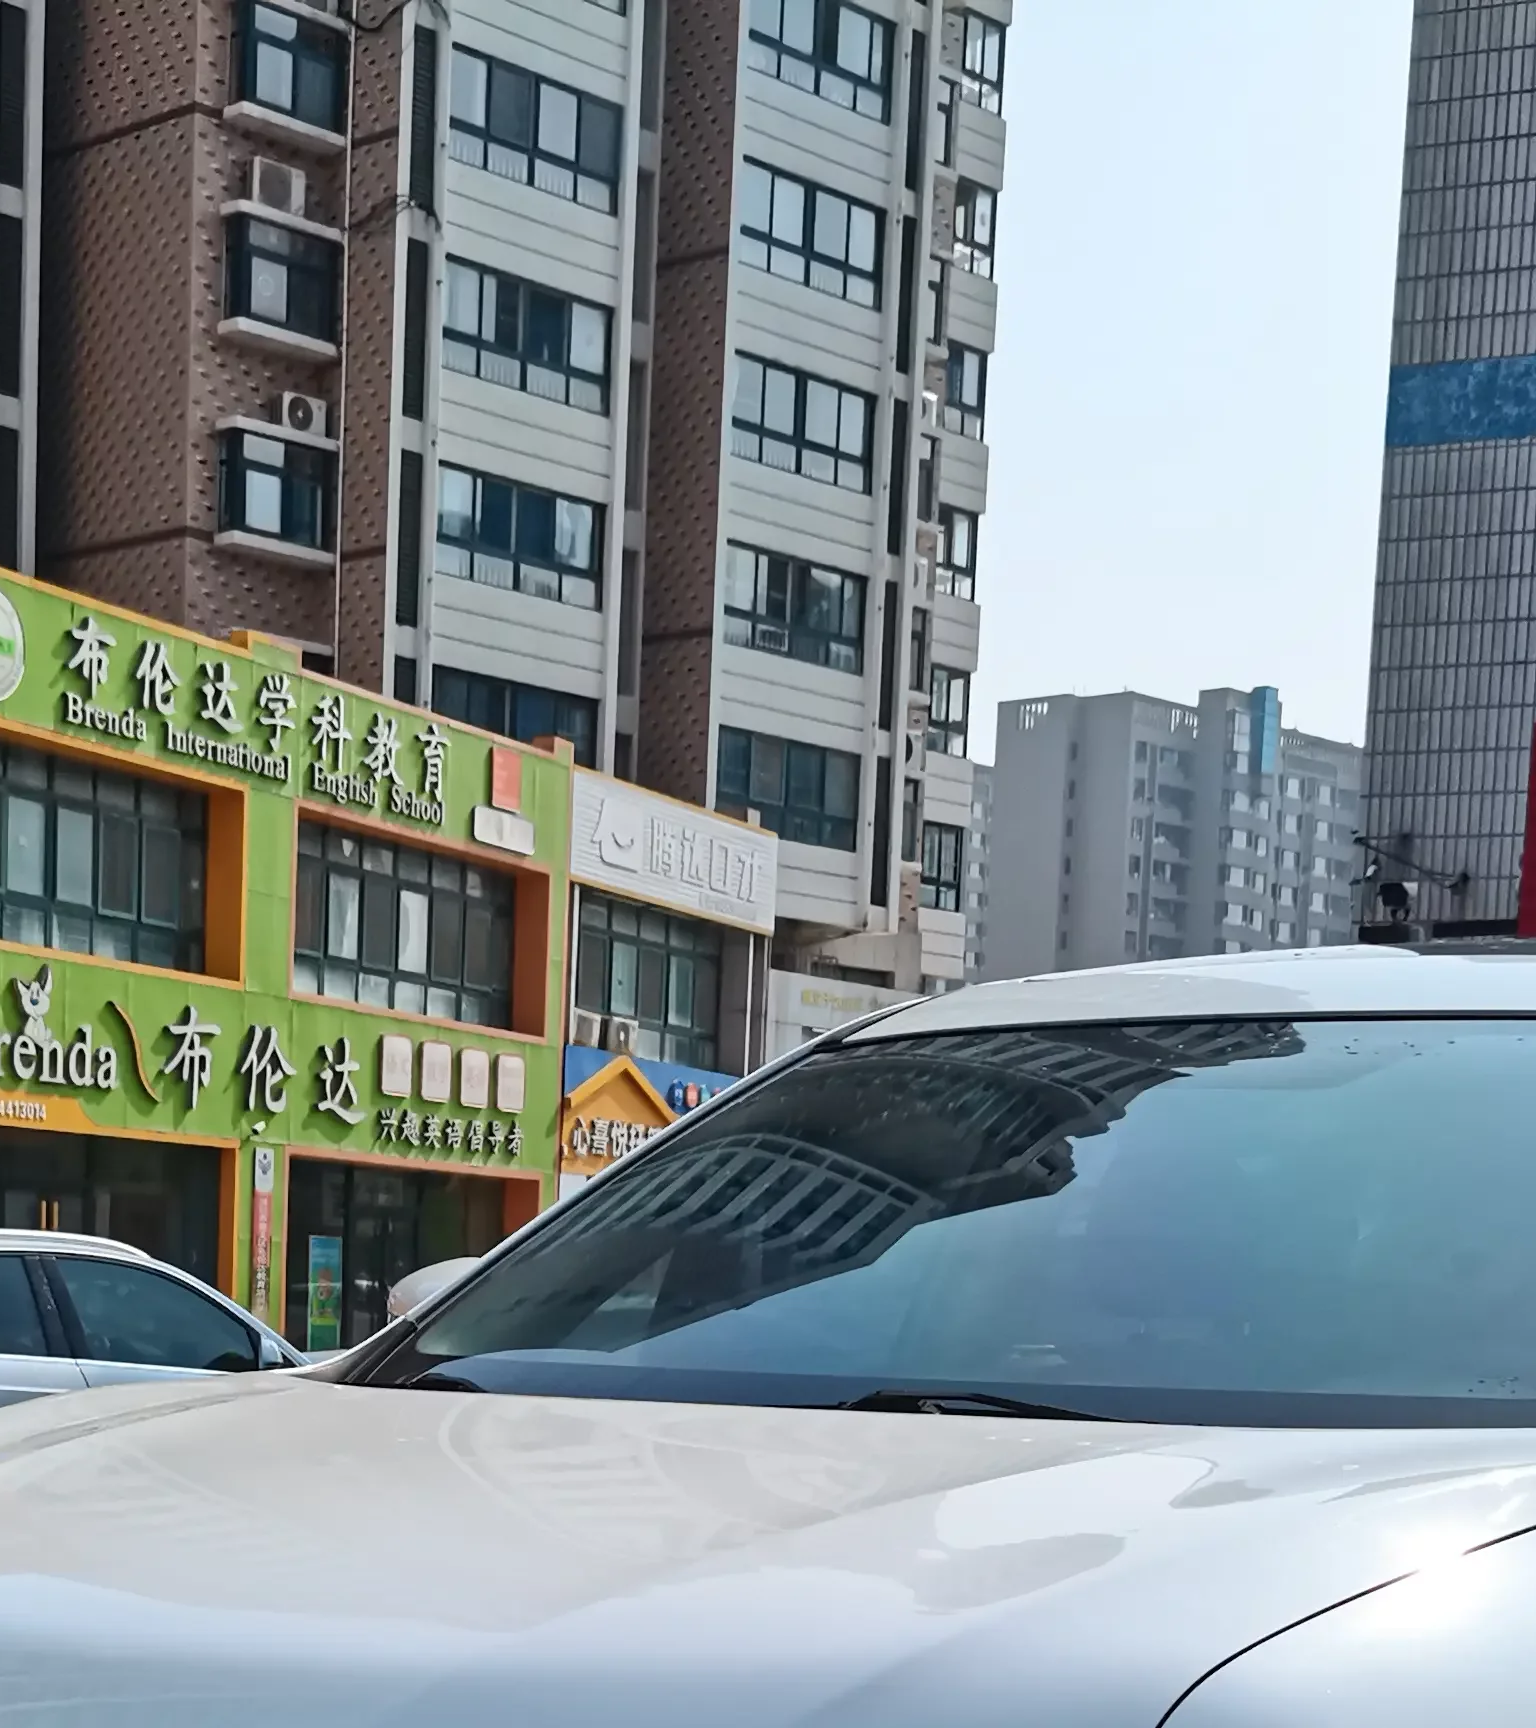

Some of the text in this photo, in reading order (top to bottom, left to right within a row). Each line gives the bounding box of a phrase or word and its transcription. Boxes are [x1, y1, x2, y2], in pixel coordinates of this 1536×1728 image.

[65, 691, 446, 826] Brenda International English School
[68, 616, 452, 802] 布伦达学科教育
[164, 1005, 367, 1125] 布伦达
[572, 1115, 664, 1158] 心喜悦
